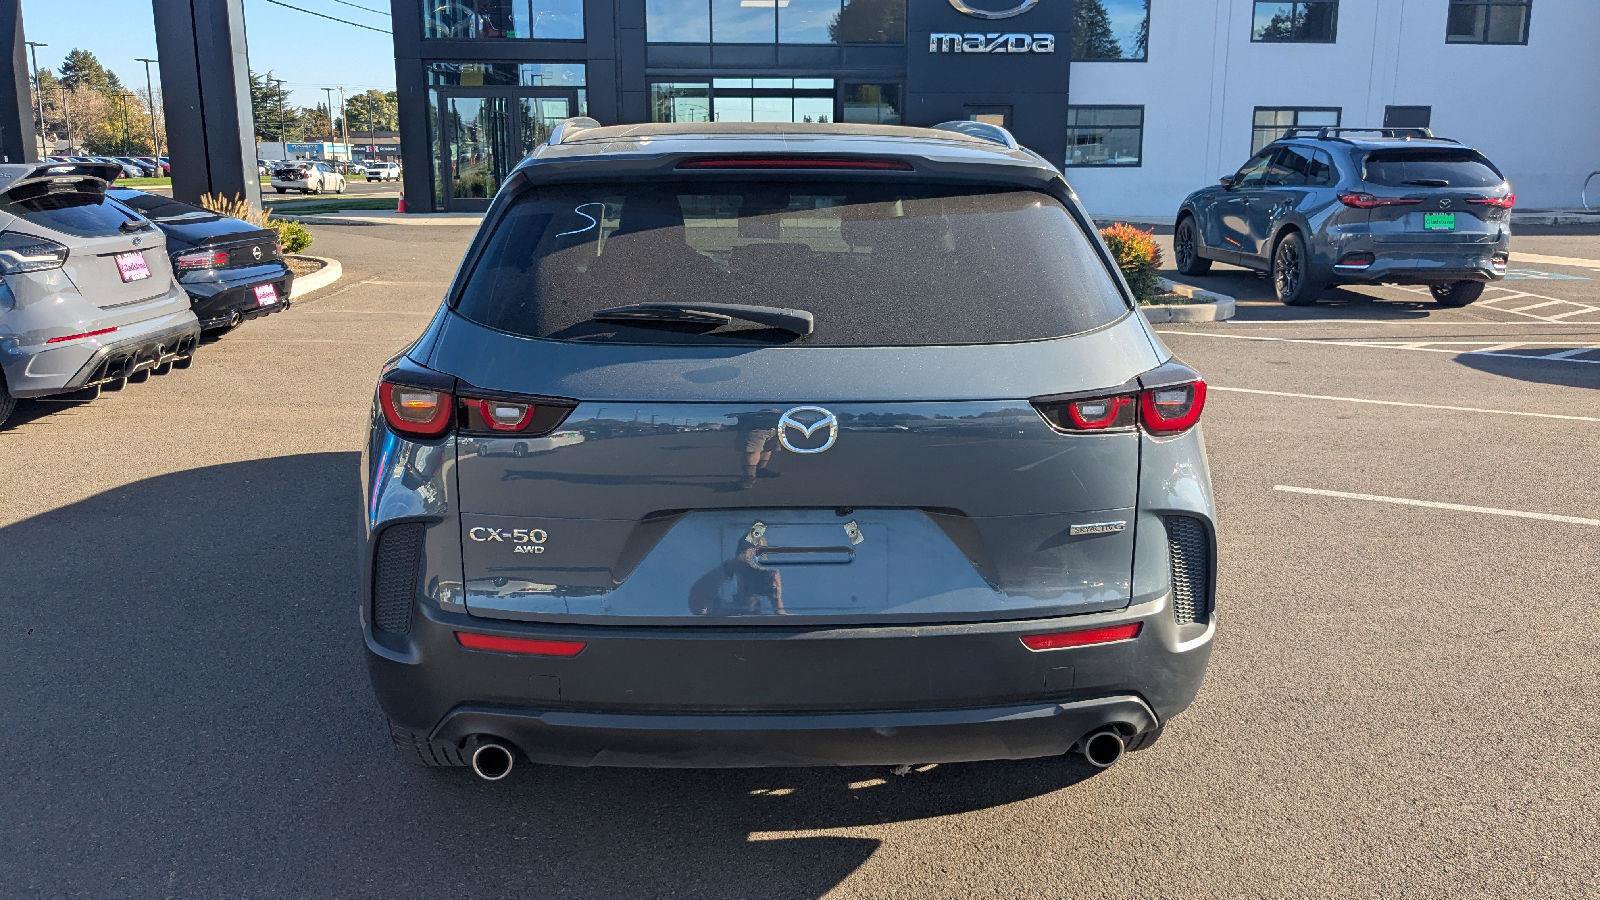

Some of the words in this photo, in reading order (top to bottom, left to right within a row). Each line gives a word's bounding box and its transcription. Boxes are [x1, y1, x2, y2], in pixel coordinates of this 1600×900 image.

[929, 33, 1055, 53] mazda
[469, 526, 548, 544] CX-50
[513, 545, 545, 554] AWD
